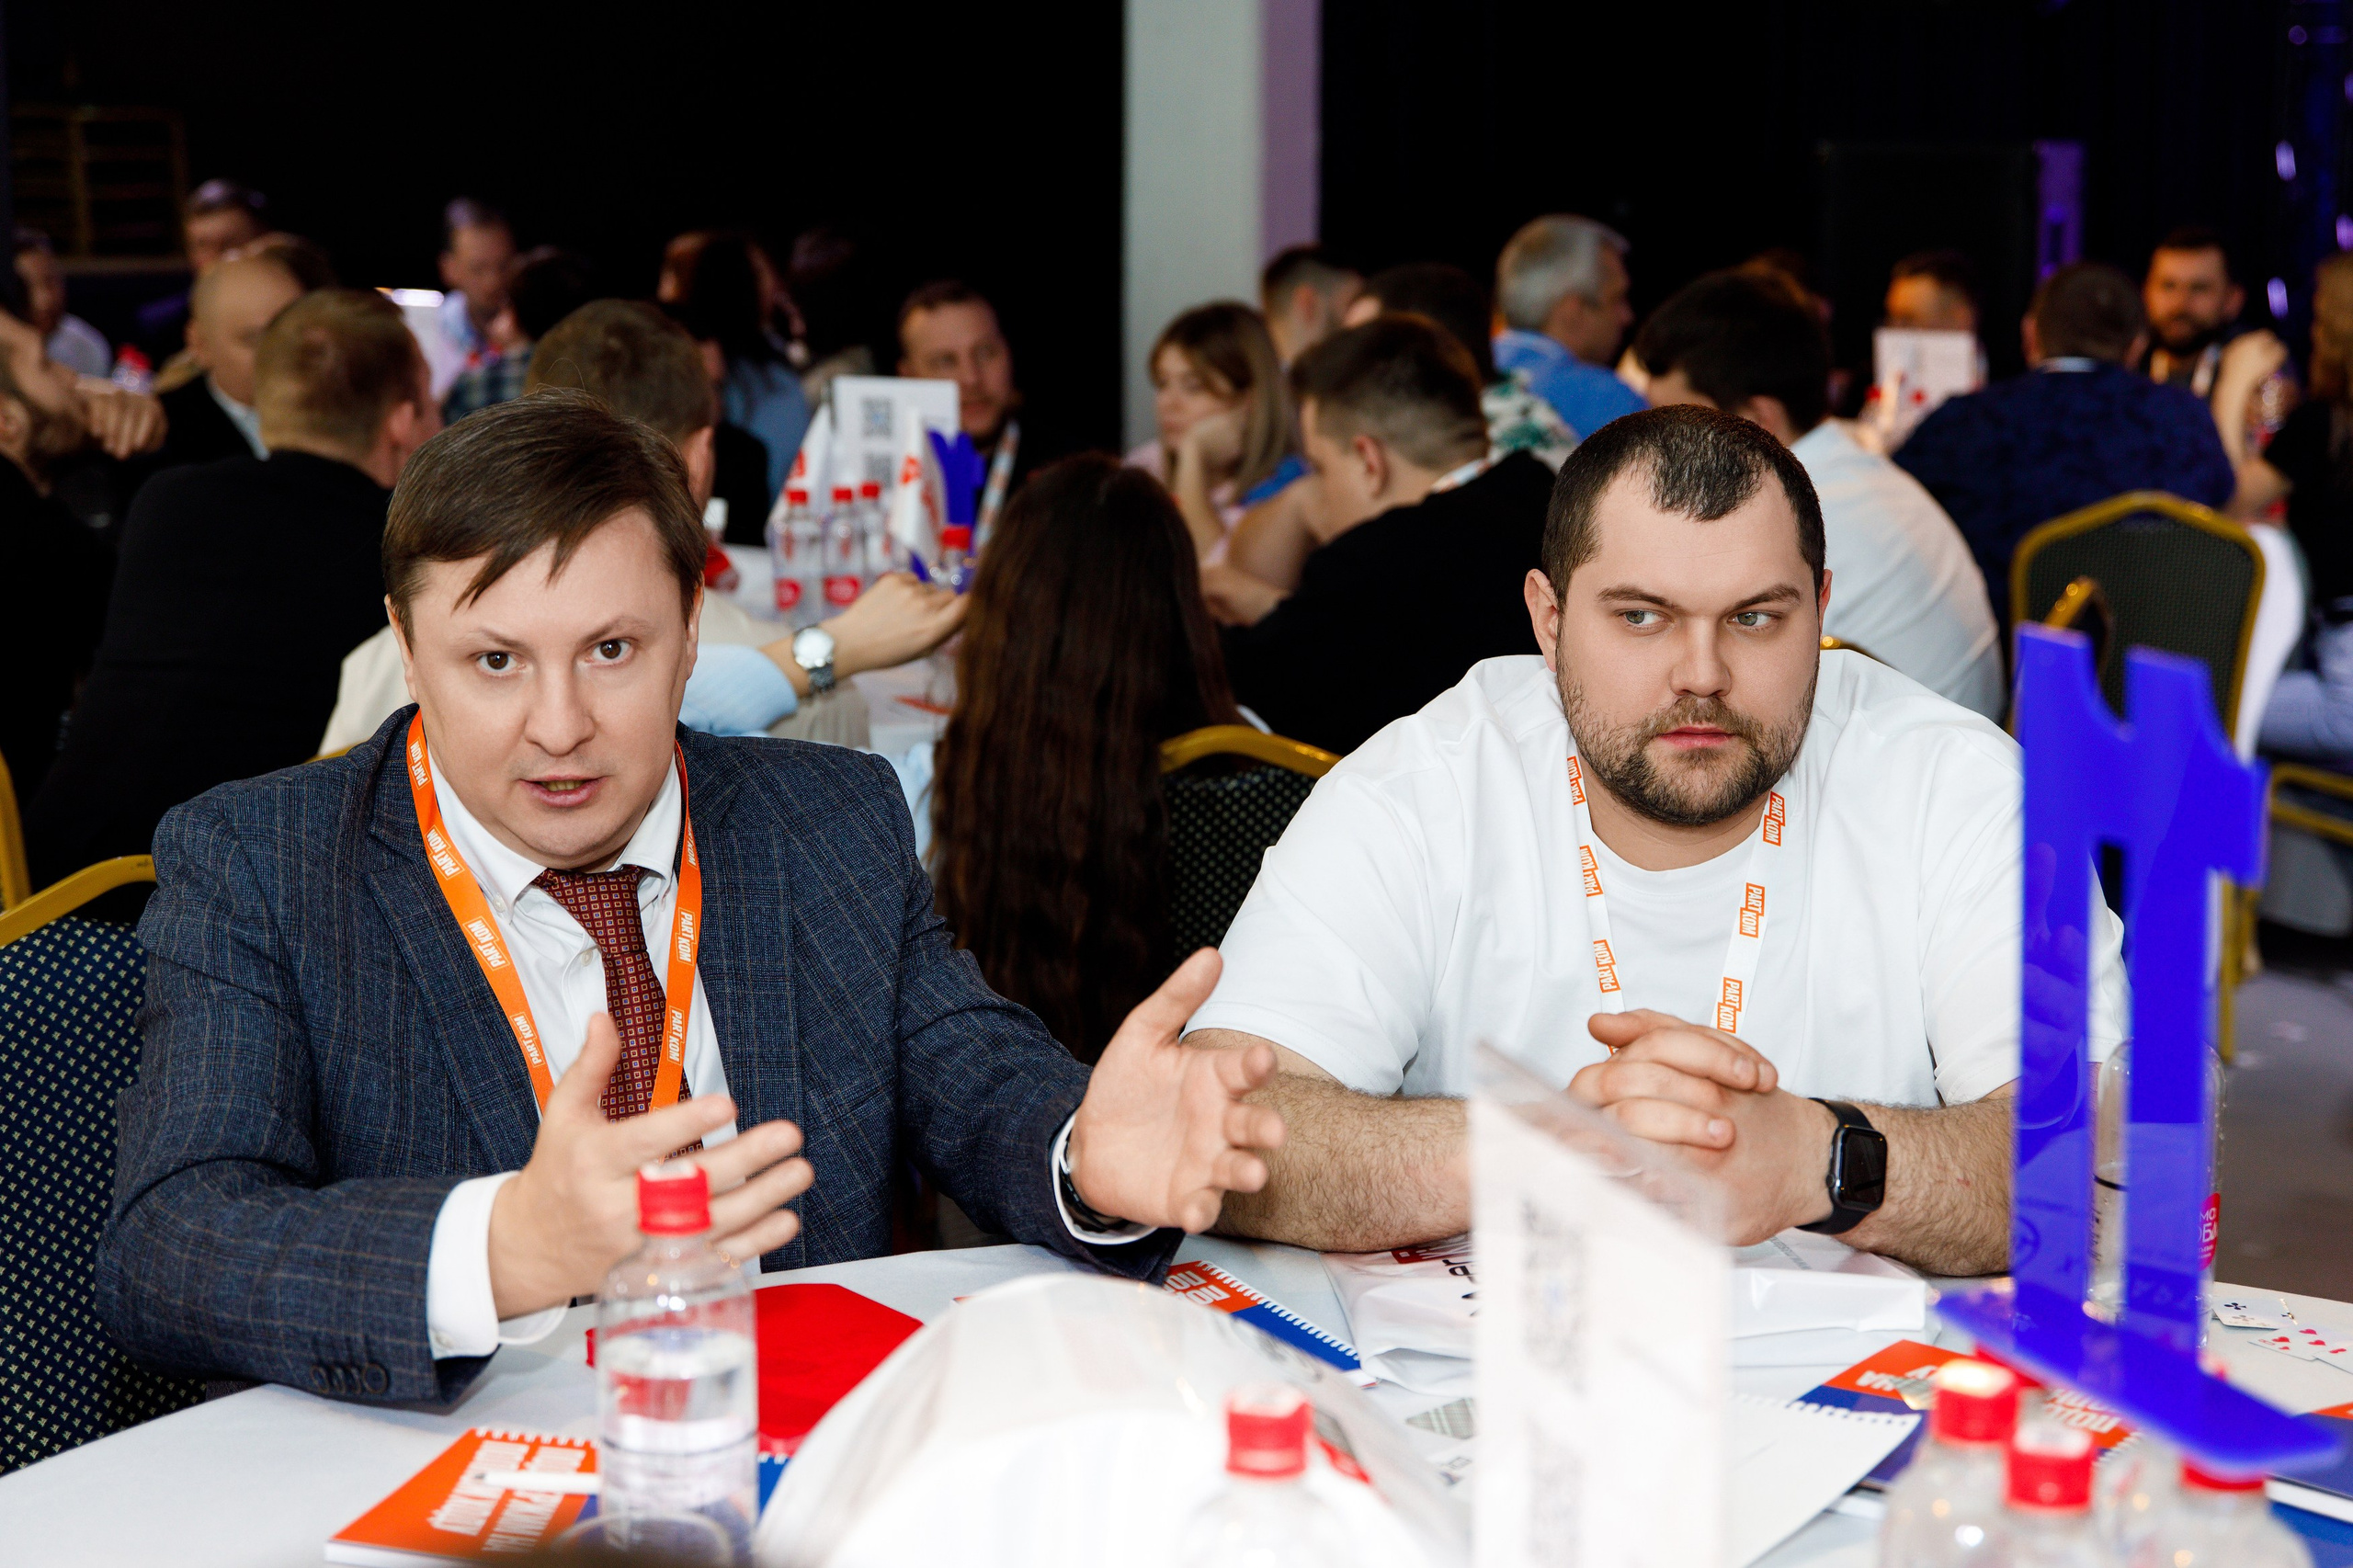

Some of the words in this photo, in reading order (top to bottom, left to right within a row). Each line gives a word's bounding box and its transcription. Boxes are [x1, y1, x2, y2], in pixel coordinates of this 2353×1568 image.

[410, 741, 424, 763] KOM
[412, 761, 428, 787] PART
[1770, 795, 1784, 825] PART
[426, 828, 447, 853] KOM
[1765, 818, 1779, 844] KOM
[432, 850, 460, 877] PART
[1748, 885, 1763, 915] PART
[468, 920, 495, 943] KOM
[680, 911, 694, 941] PART
[1743, 910, 1756, 936] KOM
[477, 941, 506, 968] PART
[677, 936, 692, 963] KOM
[1725, 980, 1740, 1010] PART
[514, 1015, 534, 1040] KOM
[671, 1009, 683, 1040] PART
[1720, 1006, 1734, 1031] KOM
[522, 1039, 542, 1065] PART
[668, 1036, 681, 1062] KOM
